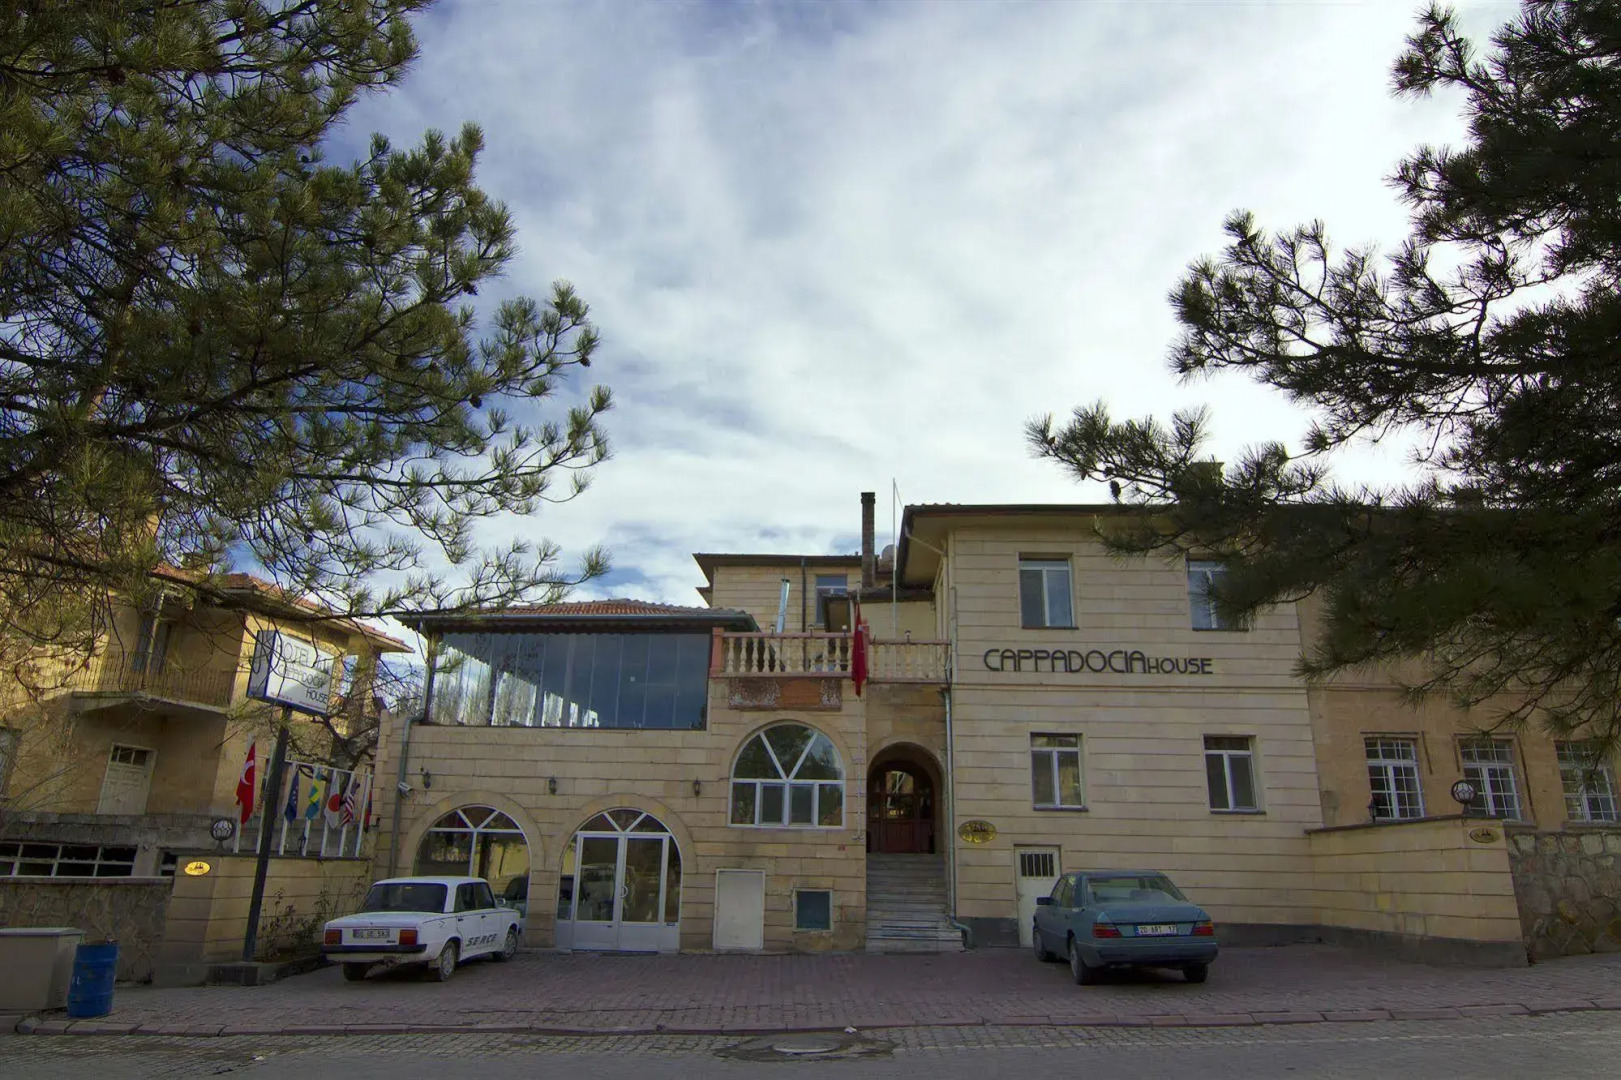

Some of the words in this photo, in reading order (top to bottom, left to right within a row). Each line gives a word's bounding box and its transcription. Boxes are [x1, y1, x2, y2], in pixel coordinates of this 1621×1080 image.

[276, 640, 312, 668] HOTEL
[983, 649, 1146, 673] CAPPADOCIA
[1147, 658, 1213, 674] HOUSE
[305, 689, 328, 704] HOUSE
